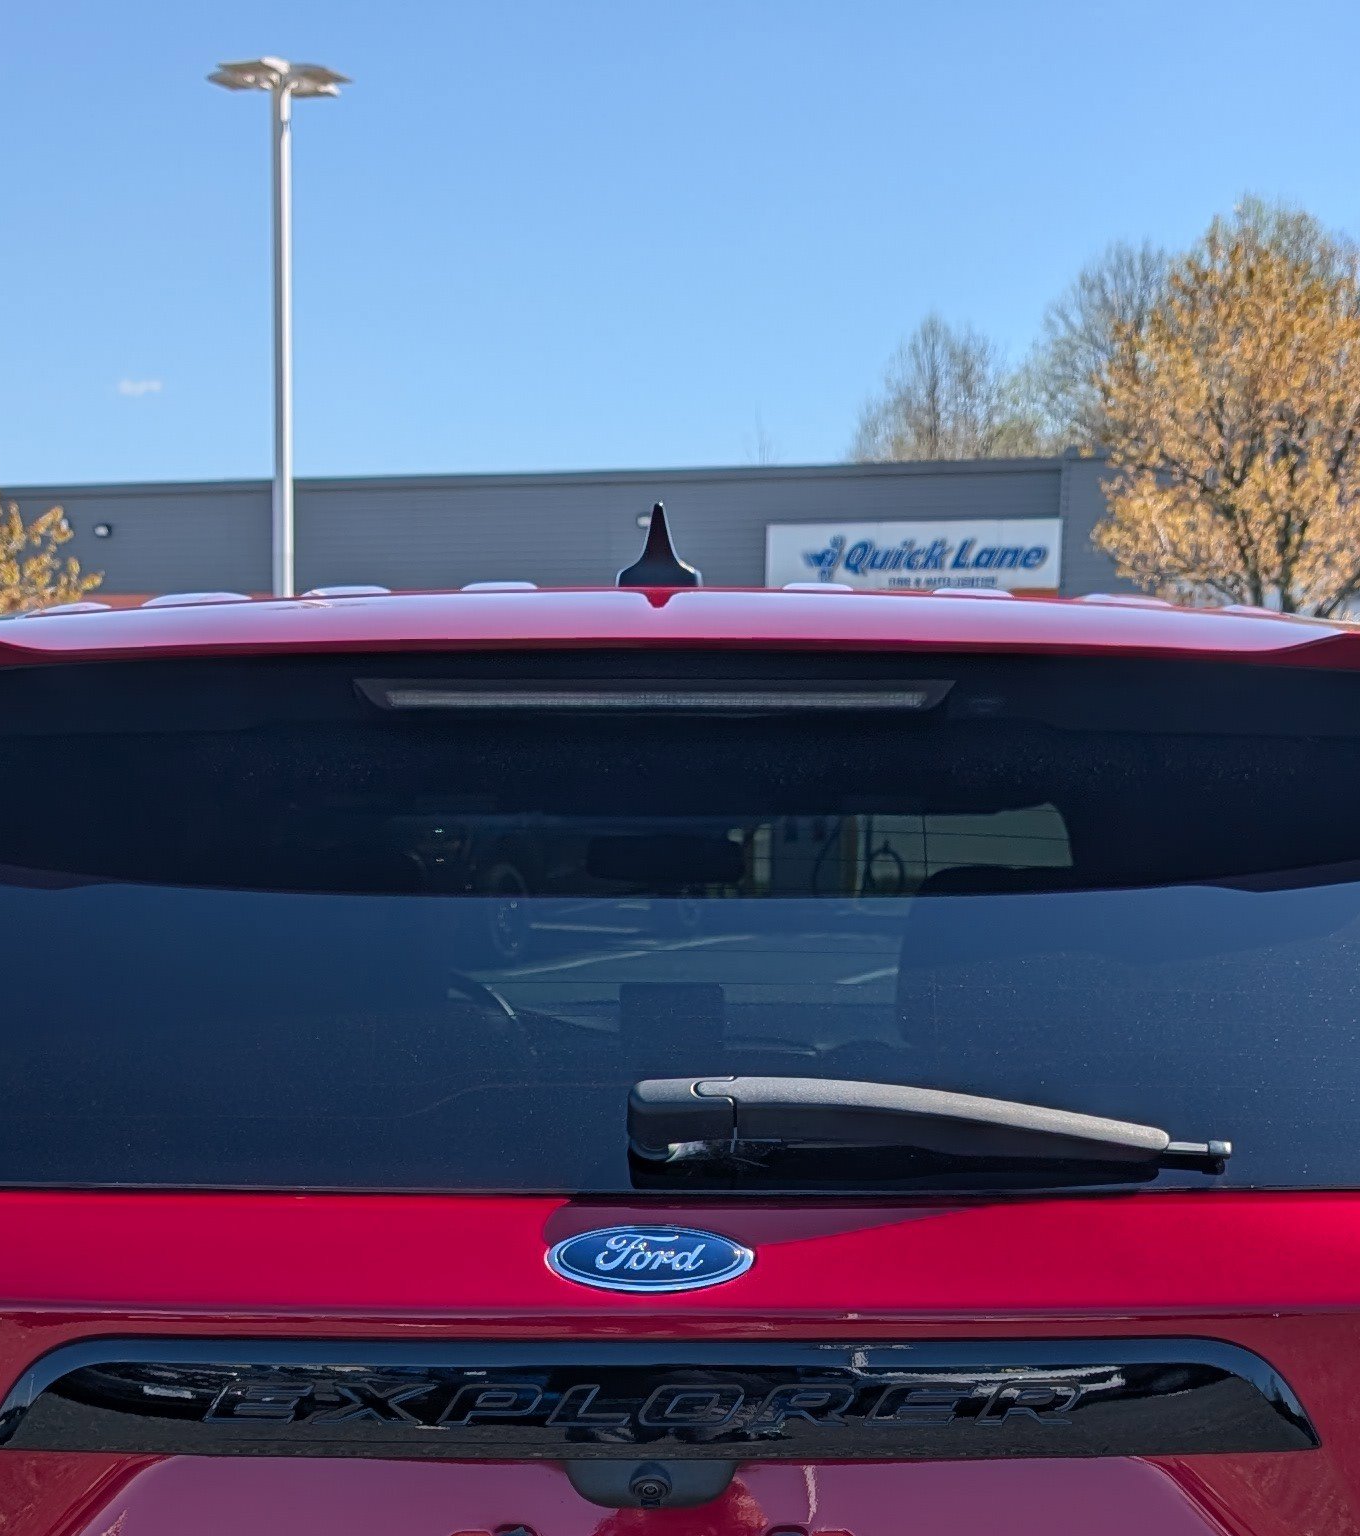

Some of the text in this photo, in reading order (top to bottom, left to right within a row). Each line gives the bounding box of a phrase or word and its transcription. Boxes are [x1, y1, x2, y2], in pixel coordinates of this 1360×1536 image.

[843, 536, 1049, 577] Quick Lane
[595, 1234, 706, 1271] Ford
[203, 1380, 1084, 1429] EXPLORER
